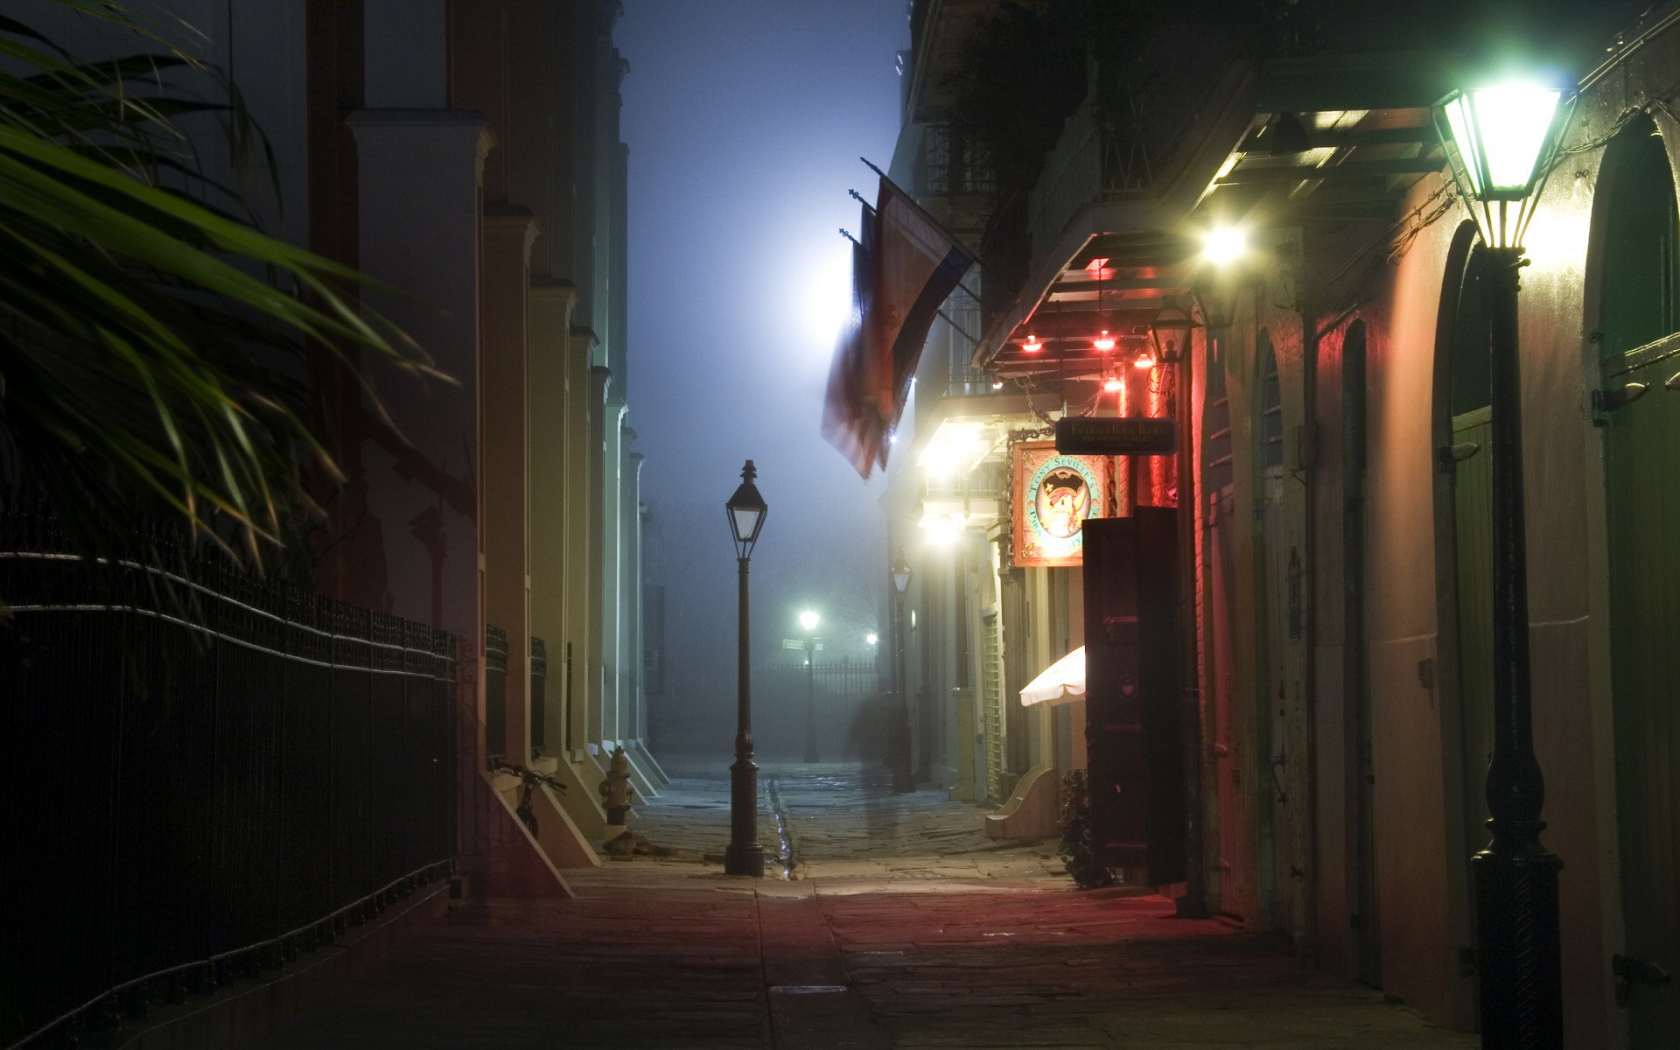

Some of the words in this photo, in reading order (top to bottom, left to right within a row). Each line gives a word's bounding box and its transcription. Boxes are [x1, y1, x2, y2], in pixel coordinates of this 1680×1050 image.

[1071, 423, 1110, 435] FAULKNER
[1112, 424, 1135, 435] HOUSE
[1138, 424, 1164, 435] BOOKS
[1031, 465, 1050, 492] TONY
